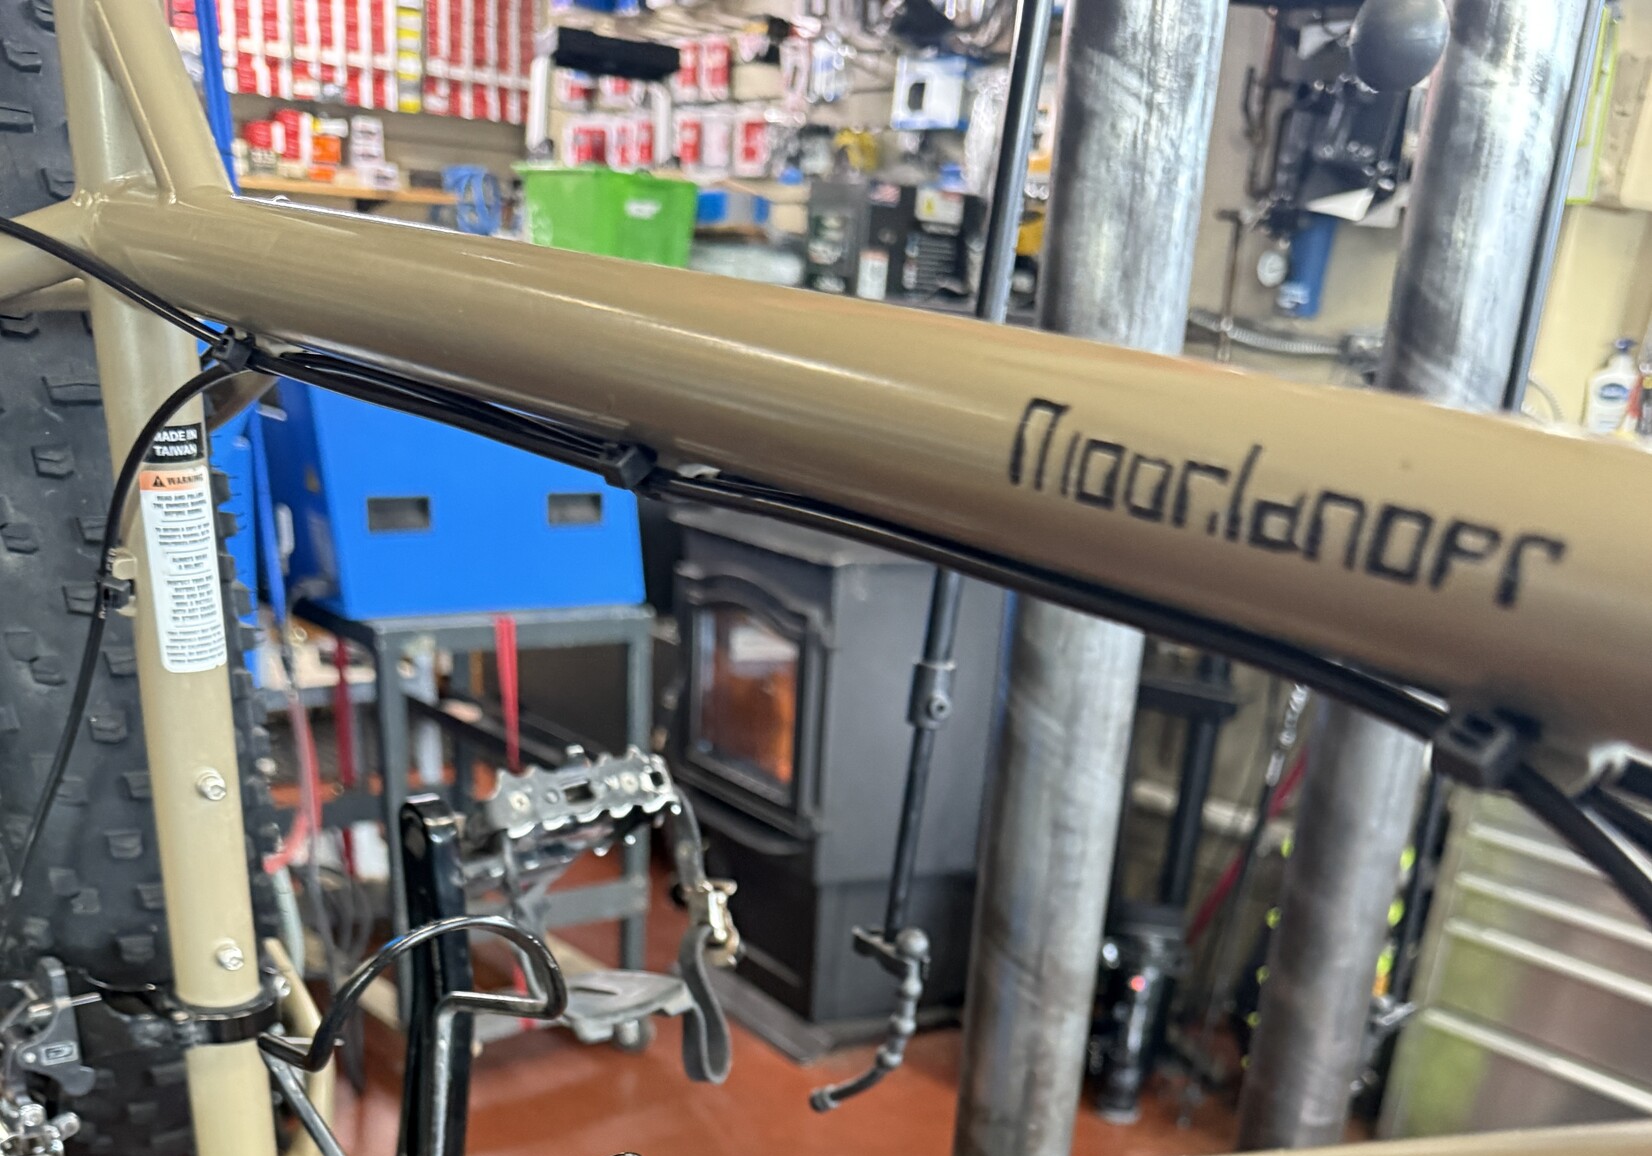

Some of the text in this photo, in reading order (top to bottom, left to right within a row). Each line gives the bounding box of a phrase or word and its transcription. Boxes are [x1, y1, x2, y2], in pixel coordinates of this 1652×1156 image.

[153, 429, 198, 442] MADE IN
[153, 443, 198, 457] TAIWAN
[167, 474, 204, 485] WARNING
